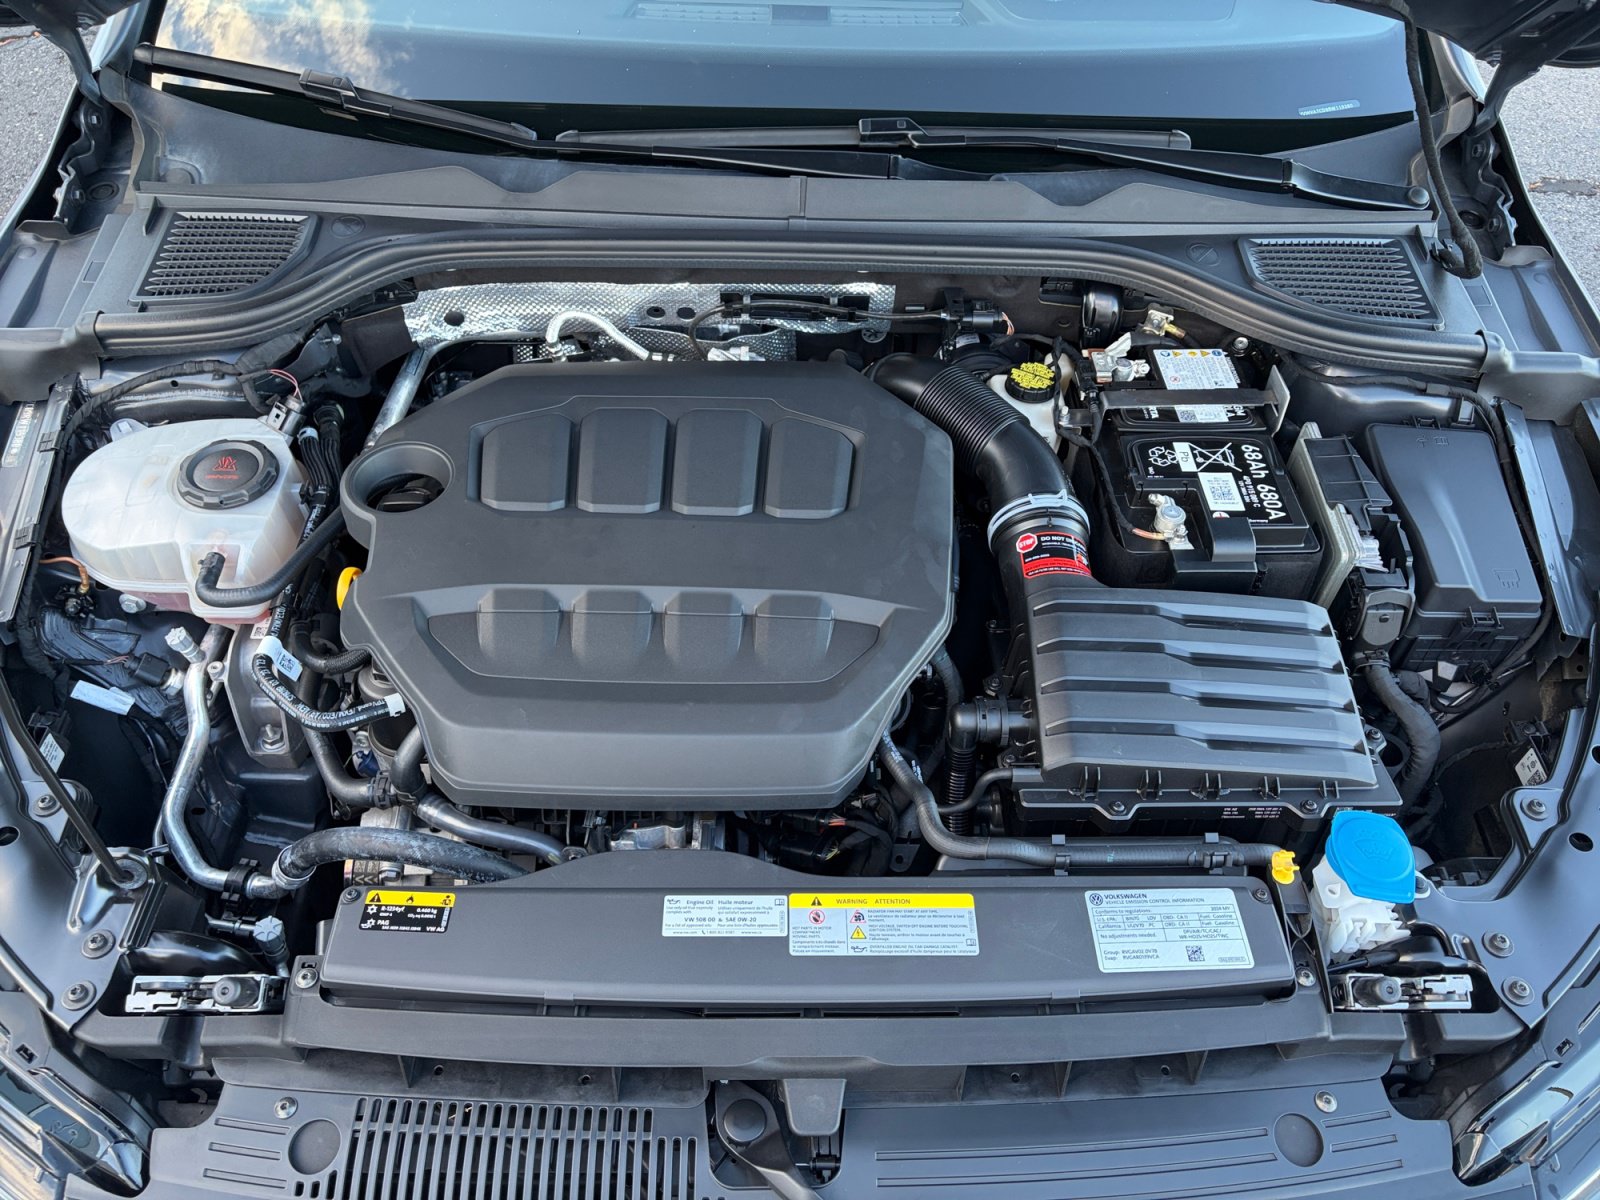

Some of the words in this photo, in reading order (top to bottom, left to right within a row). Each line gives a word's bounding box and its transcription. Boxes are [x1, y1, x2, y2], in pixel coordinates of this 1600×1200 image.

[1180, 451, 1189, 462] Pb
[1241, 444, 1269, 479] 68Ah
[1257, 484, 1286, 520] 680A
[1019, 538, 1034, 549] STOP
